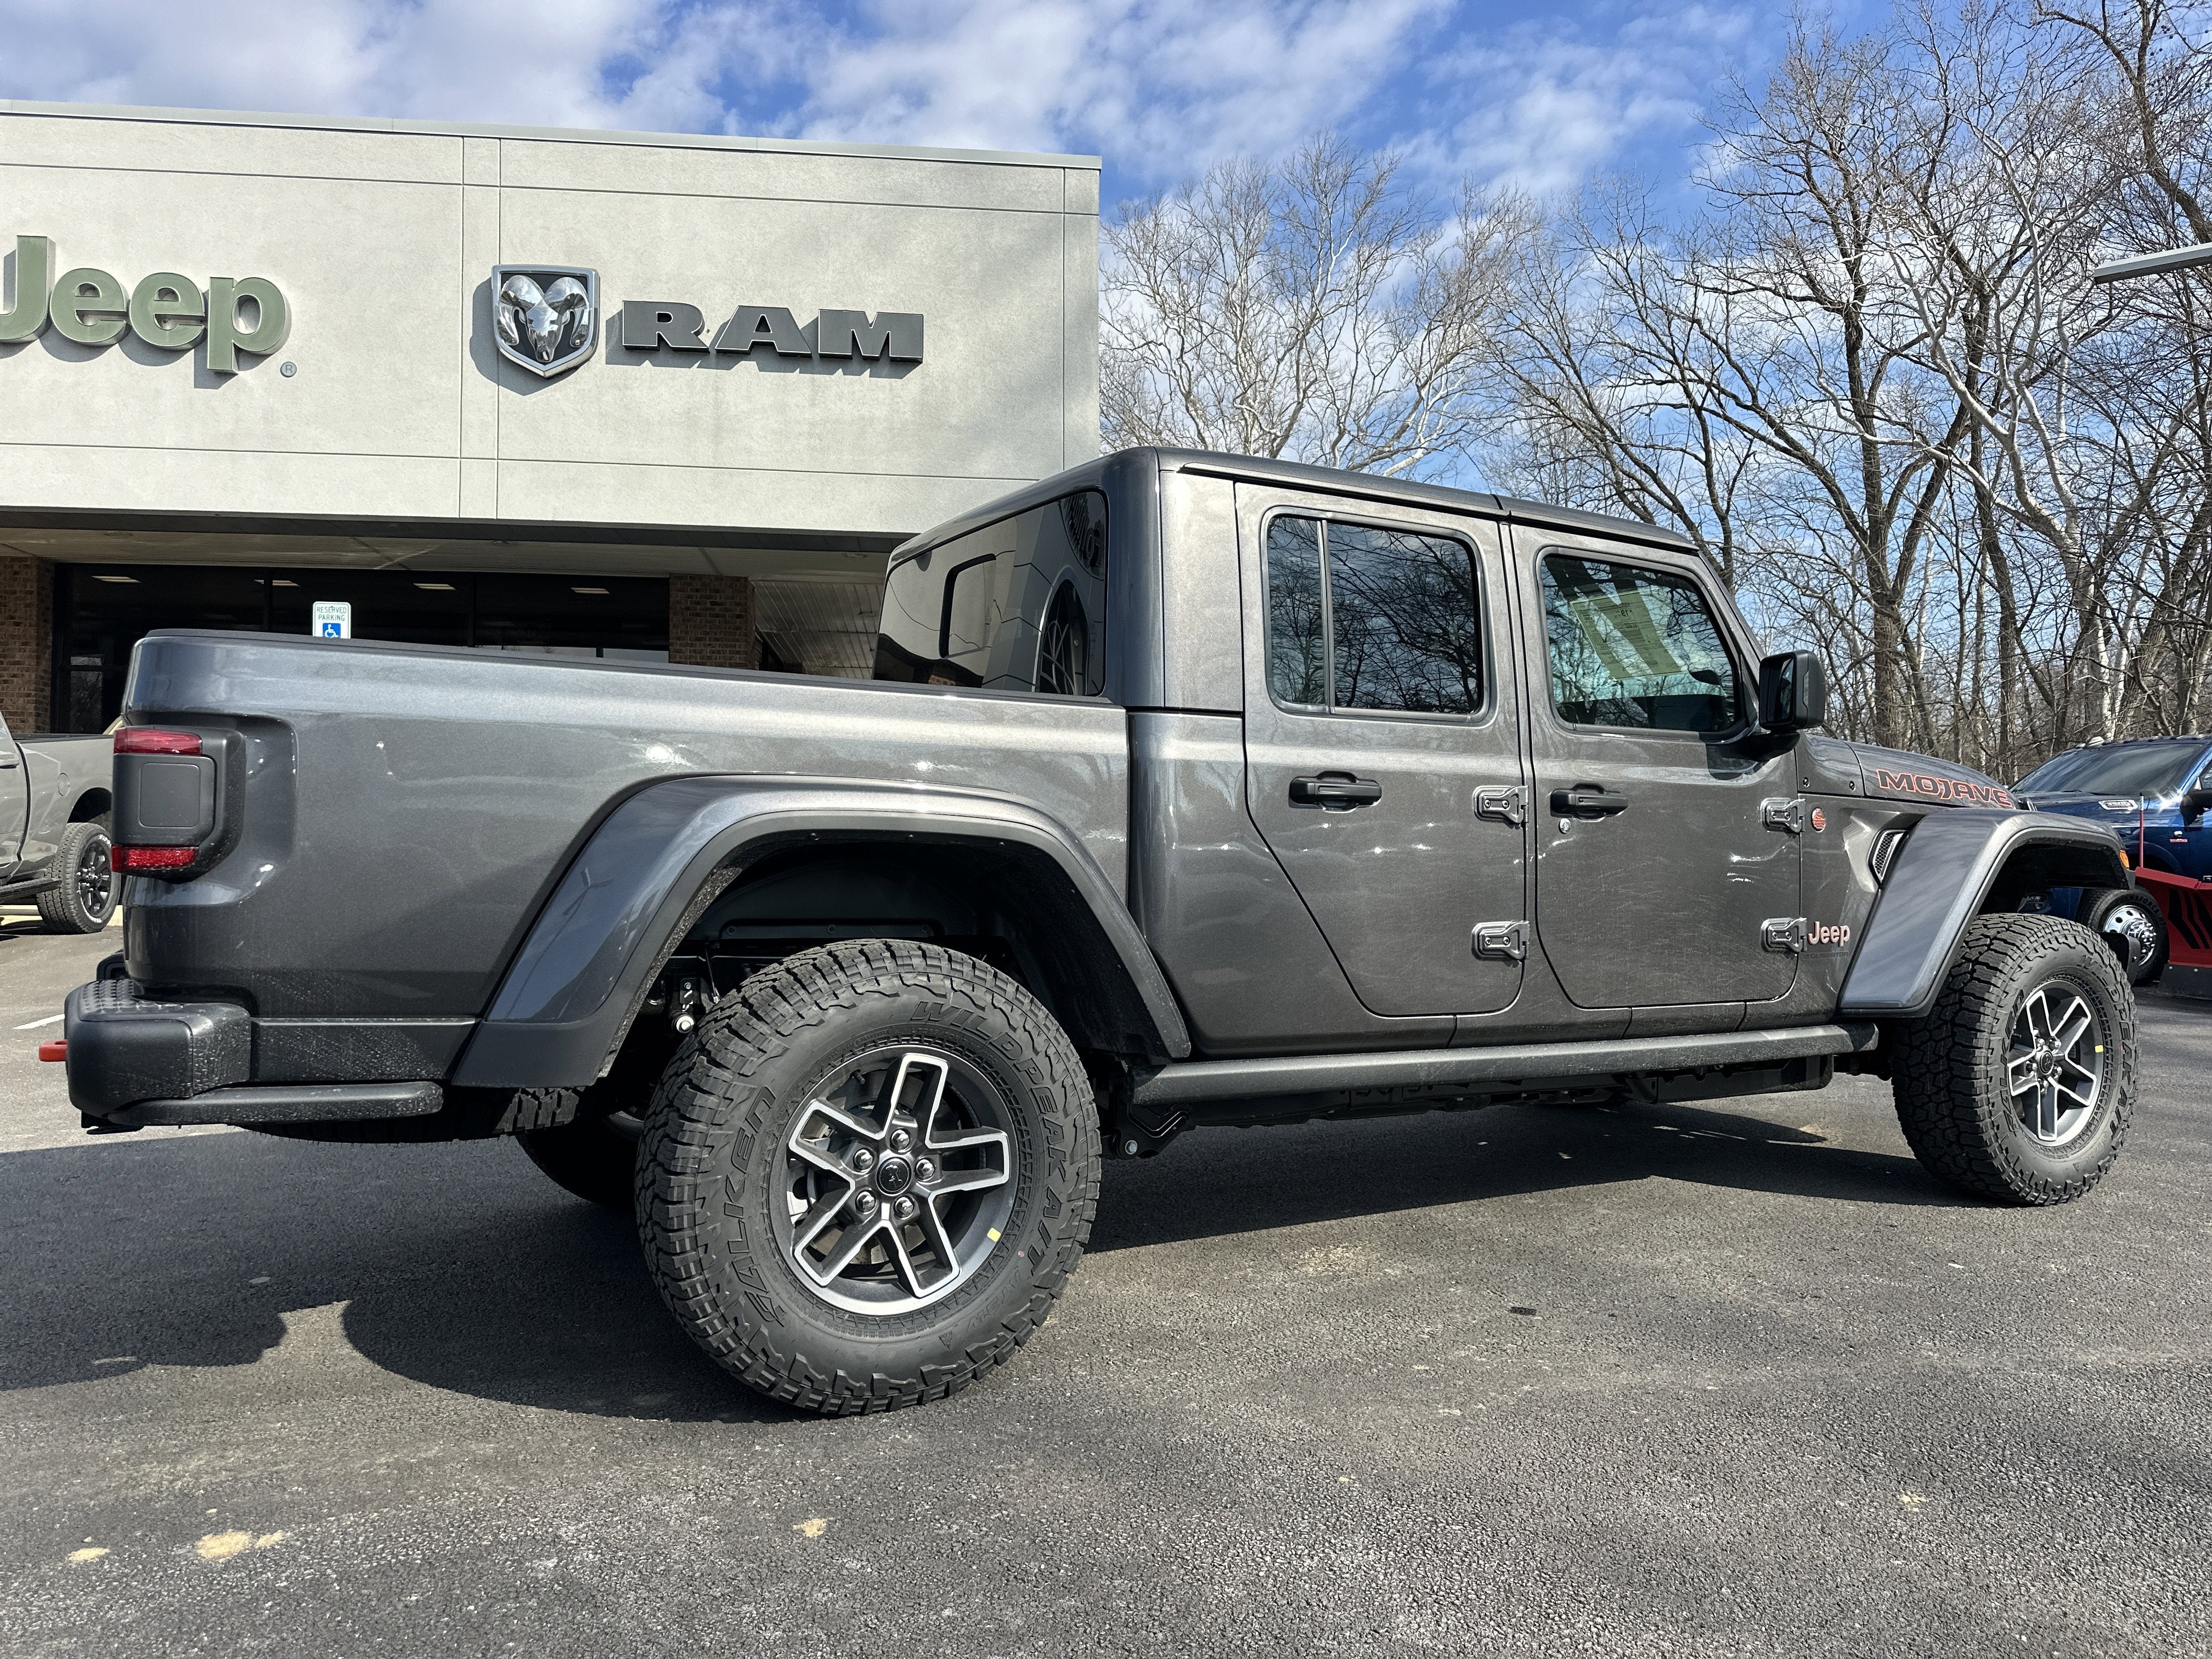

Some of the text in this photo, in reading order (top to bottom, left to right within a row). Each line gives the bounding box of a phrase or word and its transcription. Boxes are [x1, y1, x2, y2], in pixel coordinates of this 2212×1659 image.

[0, 235, 291, 374] Jeep
[622, 301, 923, 363] RAM
[1876, 769, 2013, 808] MOJAVE
[1807, 921, 1850, 948] Jeep
[2076, 953, 2132, 1086] WILDPEAK
[909, 1000, 1068, 1182] WILDPEAK
[724, 1085, 786, 1328] FALKEN
